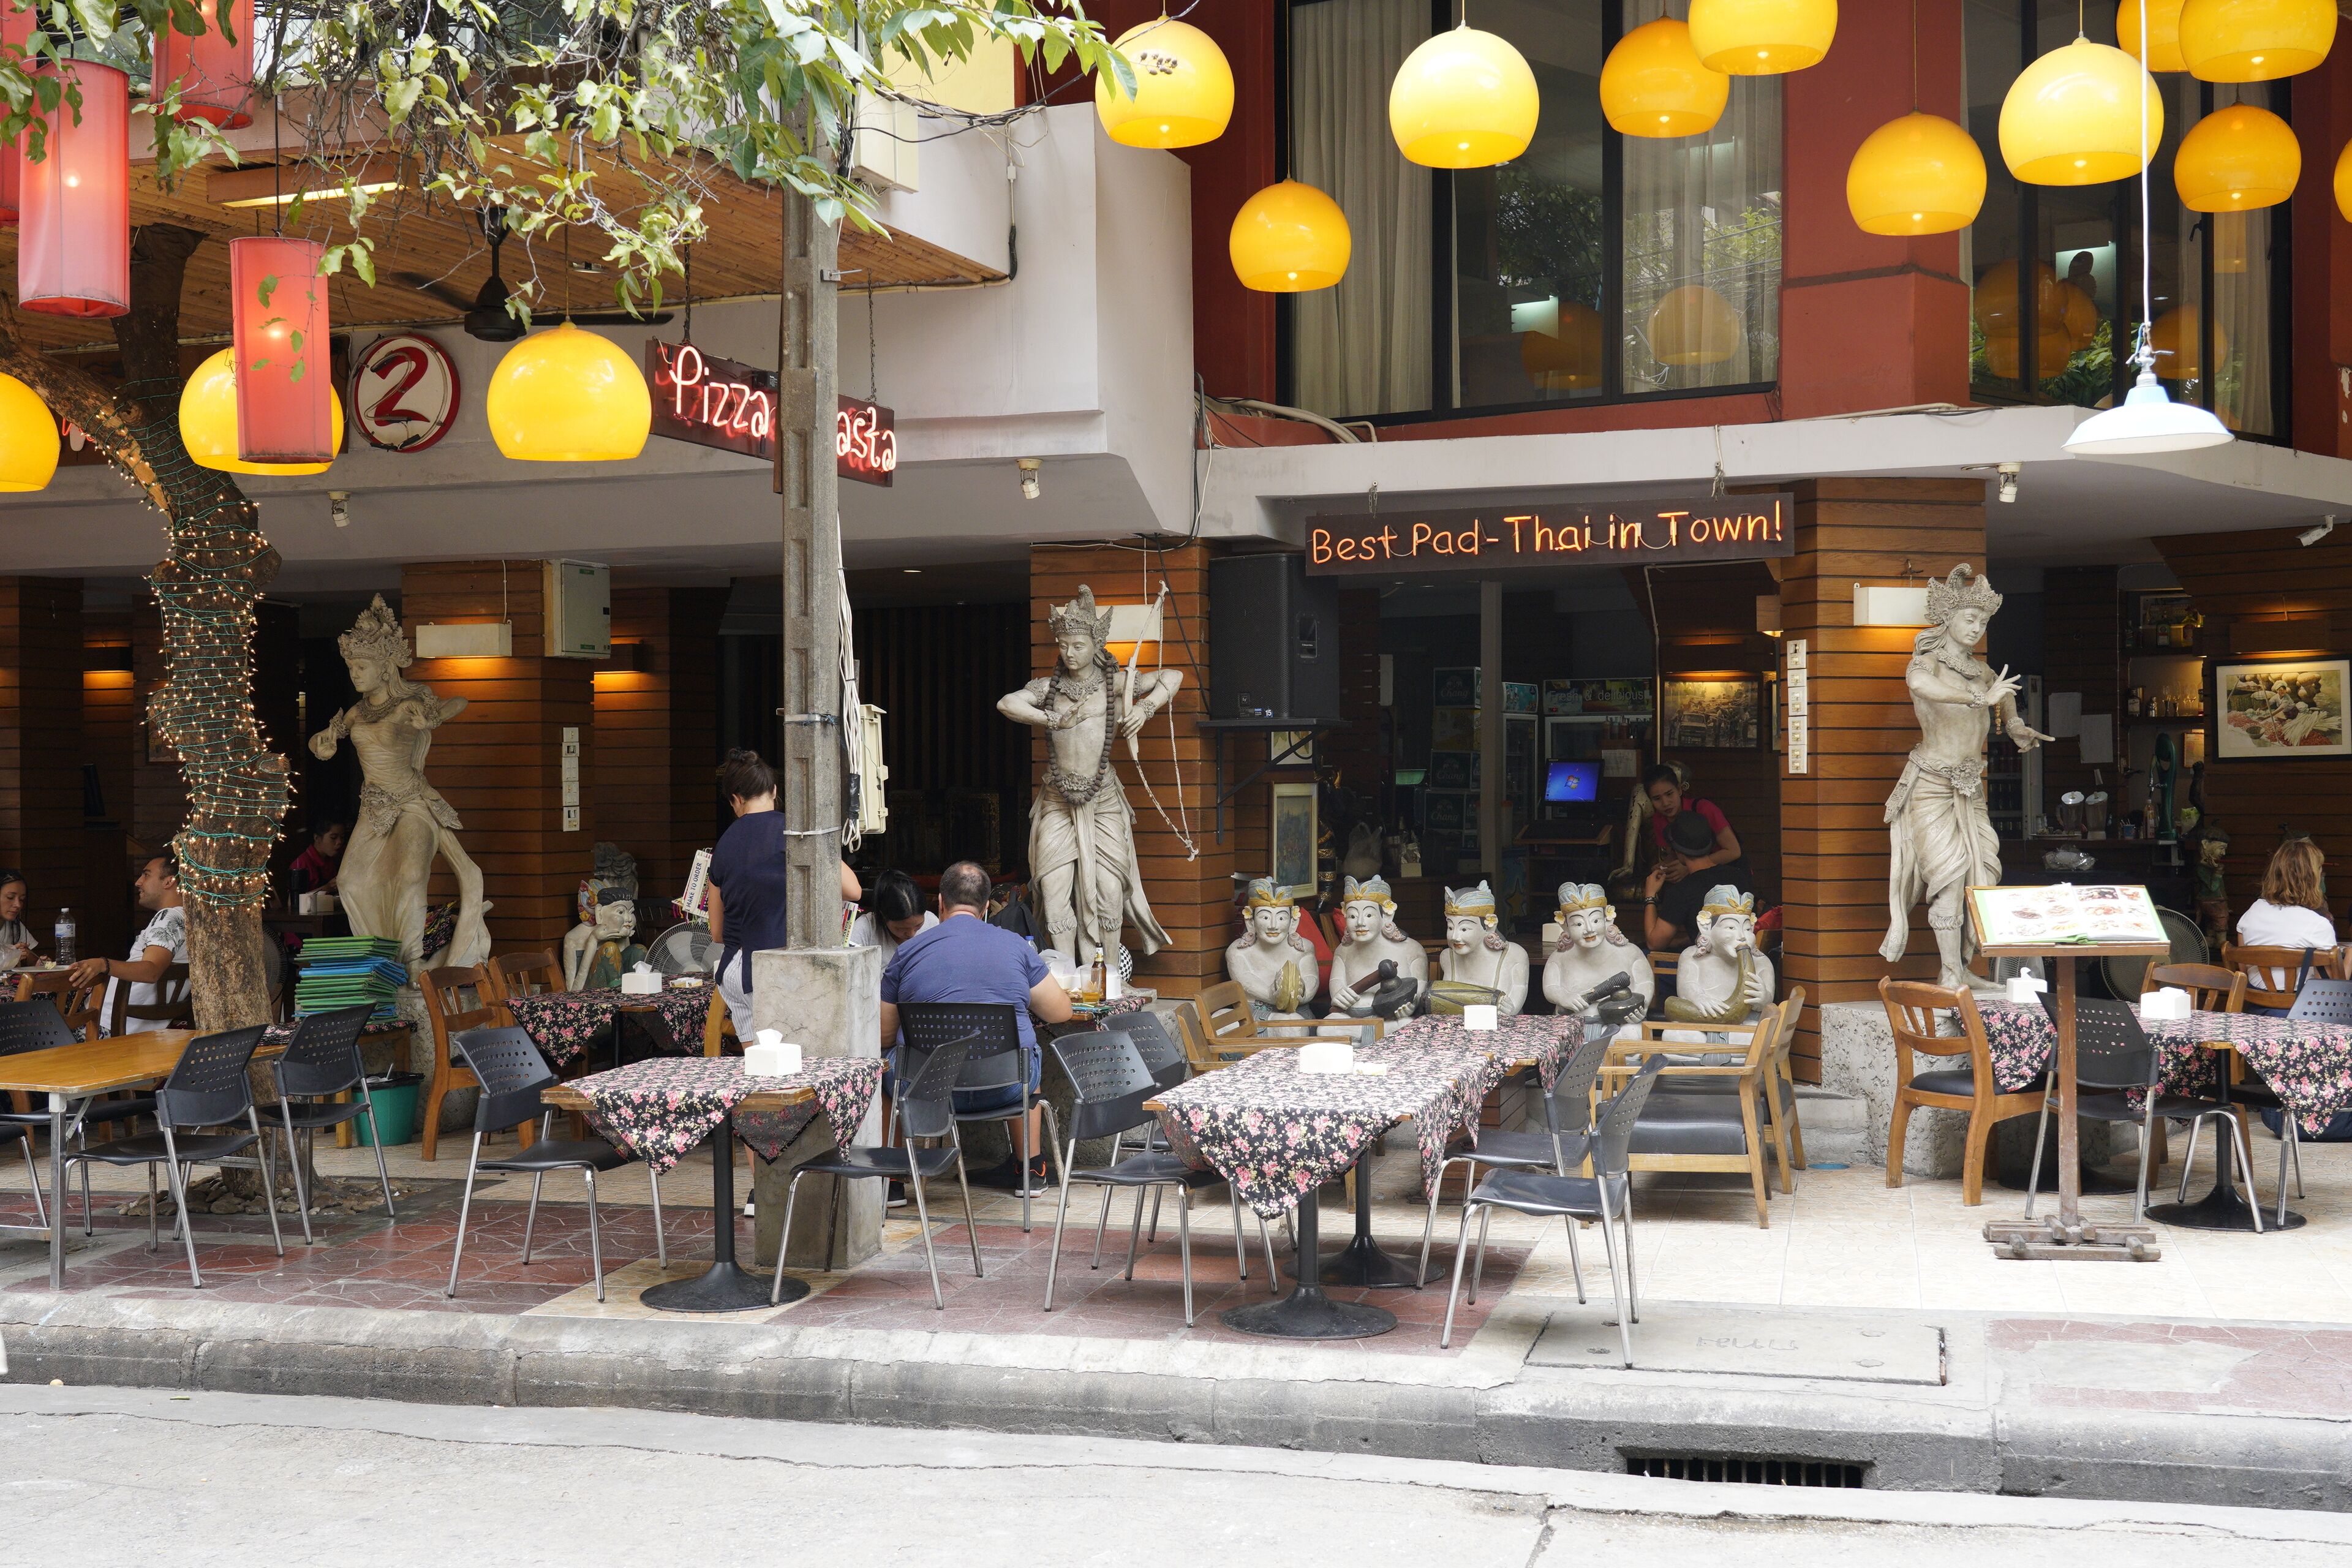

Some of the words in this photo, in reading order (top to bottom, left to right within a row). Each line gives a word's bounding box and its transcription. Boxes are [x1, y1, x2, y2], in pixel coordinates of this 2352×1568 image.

[370, 347, 430, 427] 2
[669, 345, 770, 437] Pizza
[836, 407, 896, 472] asta
[1313, 525, 1398, 564] Best
[1610, 513, 1638, 549] in
[1657, 500, 1782, 546] Town!
[1441, 687, 1469, 699] Chang
[1549, 690, 1578, 702] Fresh
[1585, 690, 1593, 701] &
[1597, 688, 1645, 701] delicious
[1431, 811, 1460, 823] Chang
[693, 862, 702, 881] ORDER
[691, 882, 696, 891] TO
